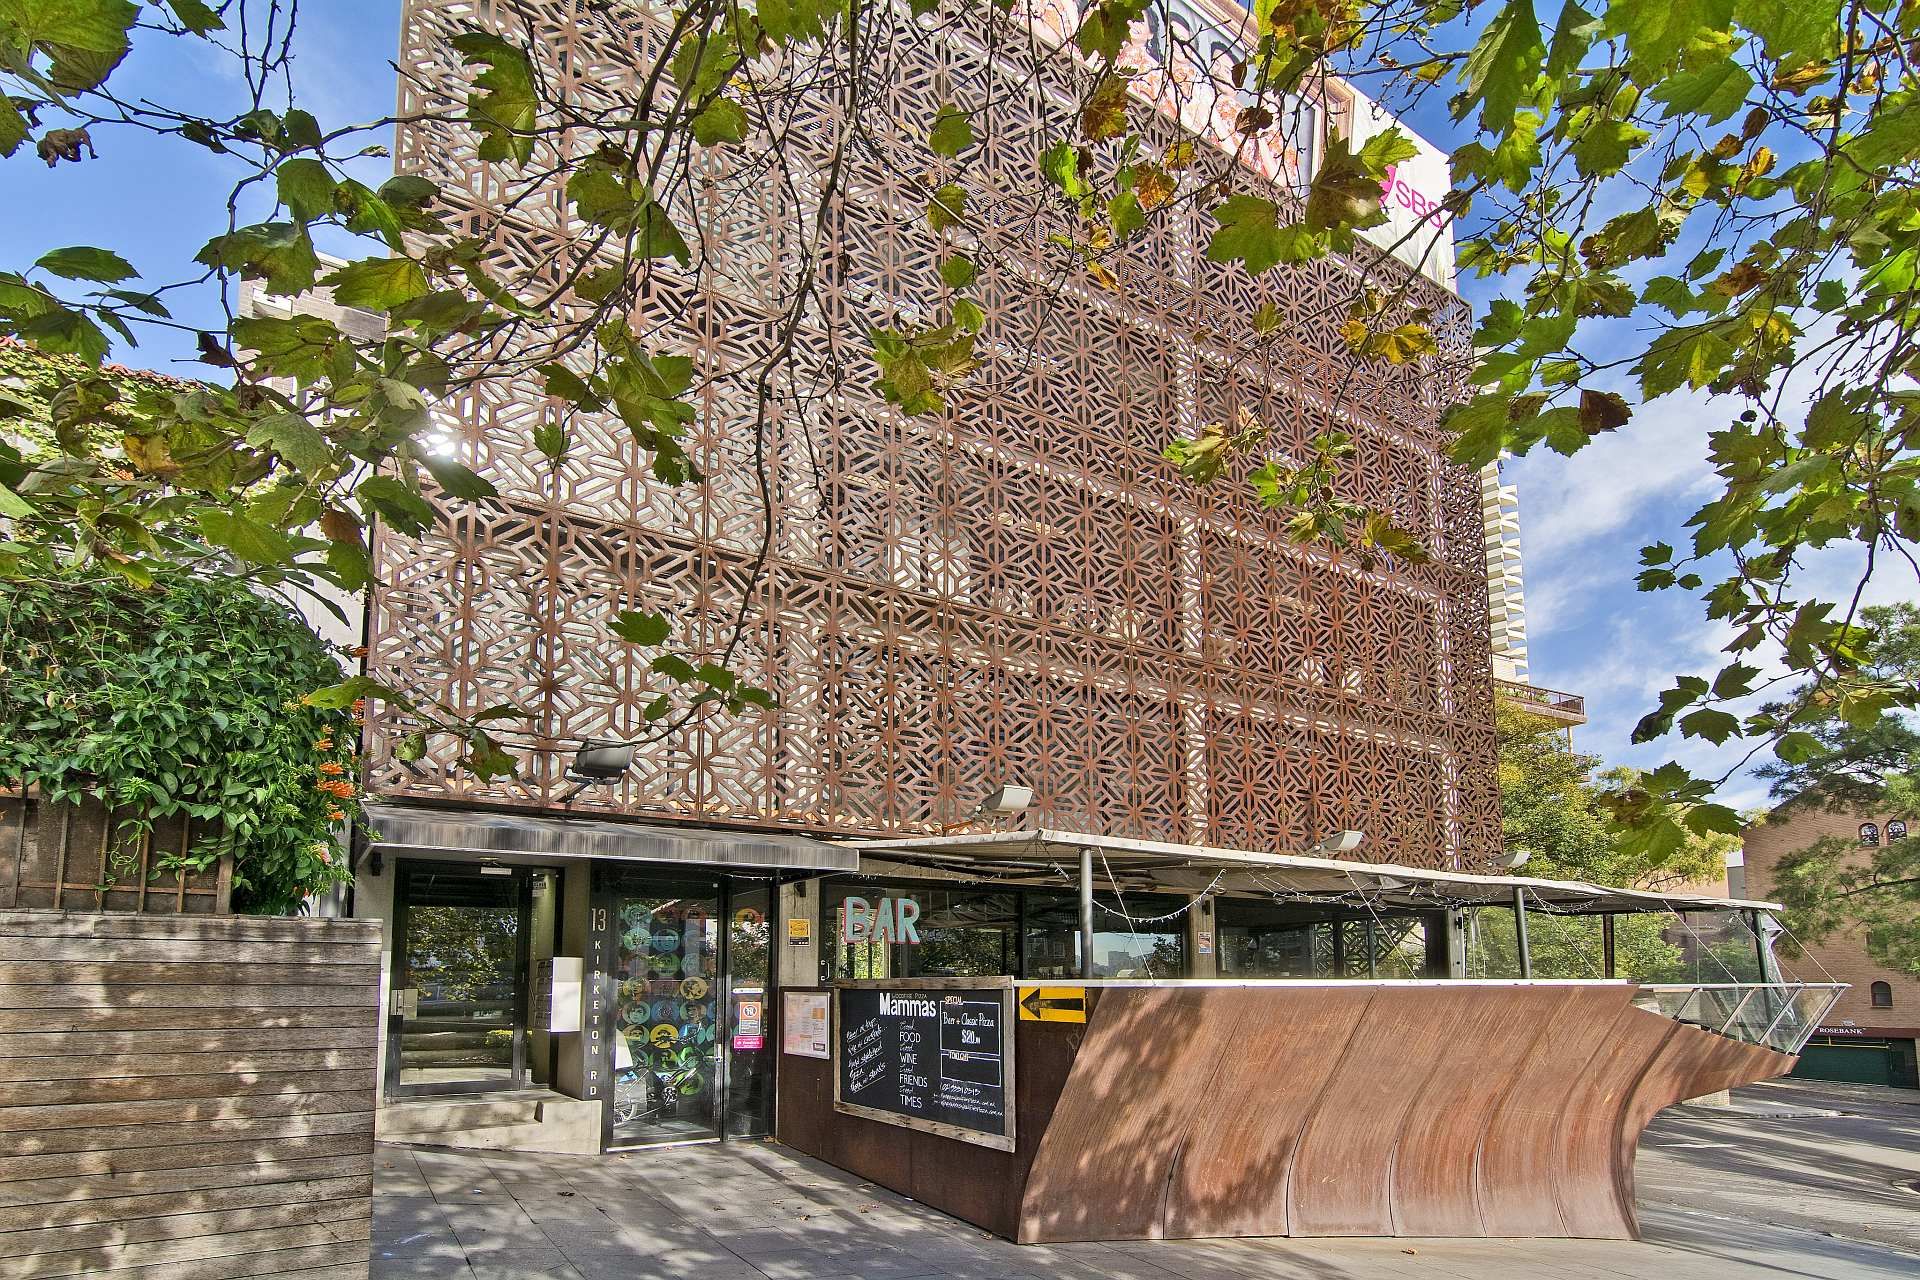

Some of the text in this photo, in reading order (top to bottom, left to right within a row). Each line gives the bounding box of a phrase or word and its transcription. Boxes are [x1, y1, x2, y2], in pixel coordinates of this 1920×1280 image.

[1395, 179, 1443, 229] SBS
[591, 907, 607, 932] 13
[843, 896, 920, 944] BAR
[879, 992, 937, 1018] Mammas
[589, 940, 601, 1096] KIRKETON RD
[978, 1012, 995, 1027] Pizza
[899, 1031, 921, 1043] FOOD
[900, 1053, 918, 1065] WINE
[899, 1073, 928, 1088] FRIENDS
[900, 1094, 923, 1109] TIMES
